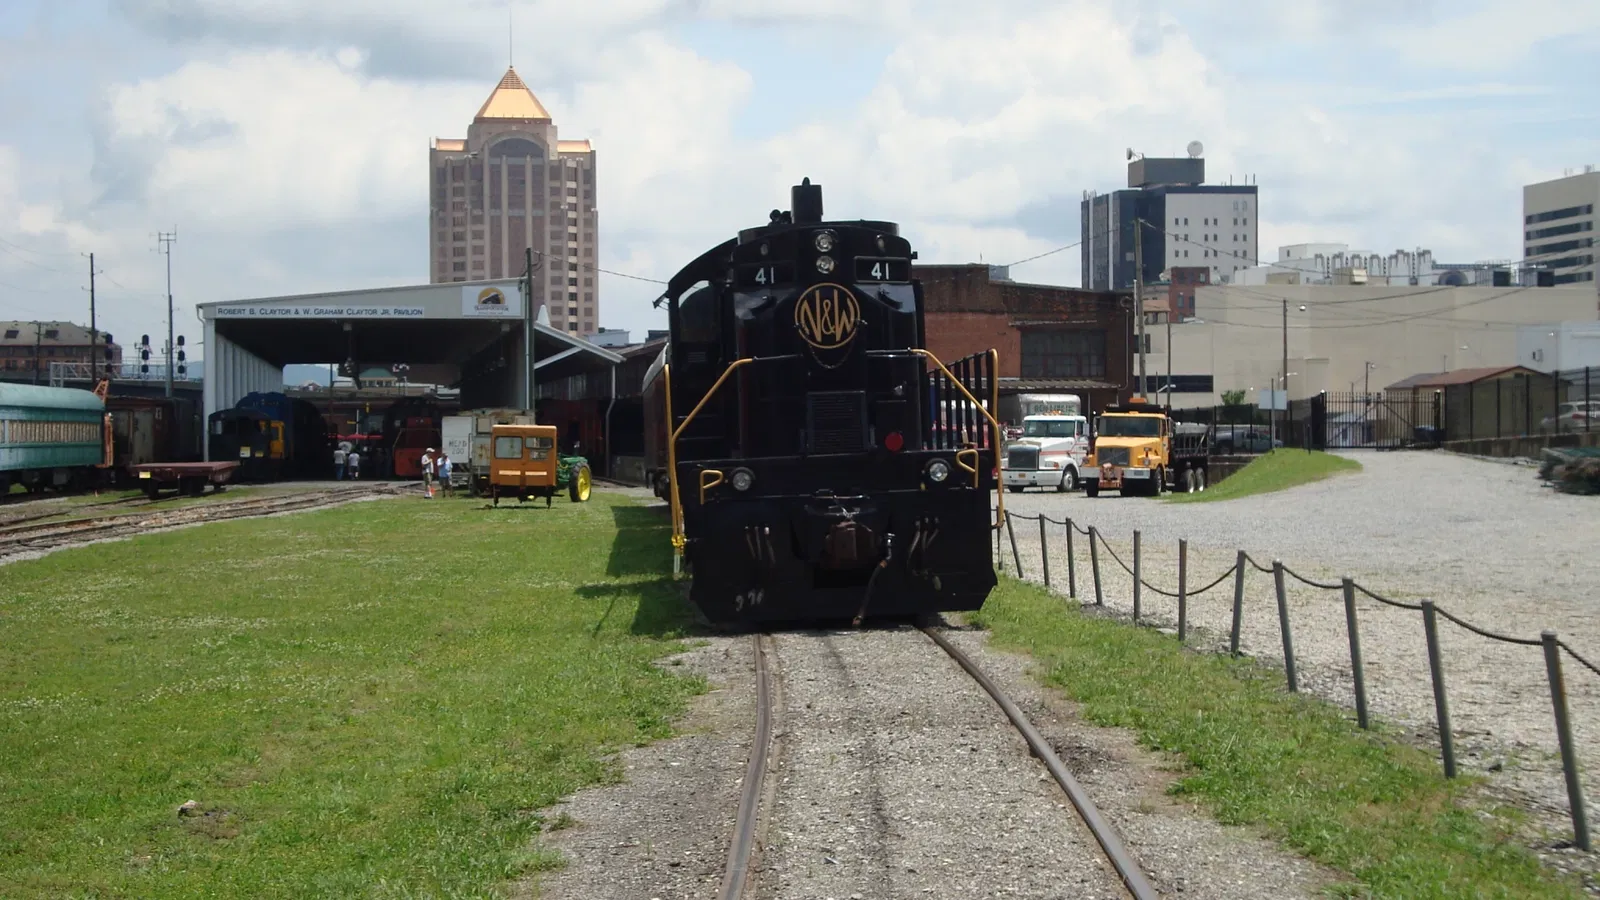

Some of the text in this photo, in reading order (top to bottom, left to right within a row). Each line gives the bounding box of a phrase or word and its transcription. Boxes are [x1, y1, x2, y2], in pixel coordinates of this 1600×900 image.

[755, 267, 775, 285] 41
[871, 262, 890, 280] 41
[800, 289, 856, 342] N&W
